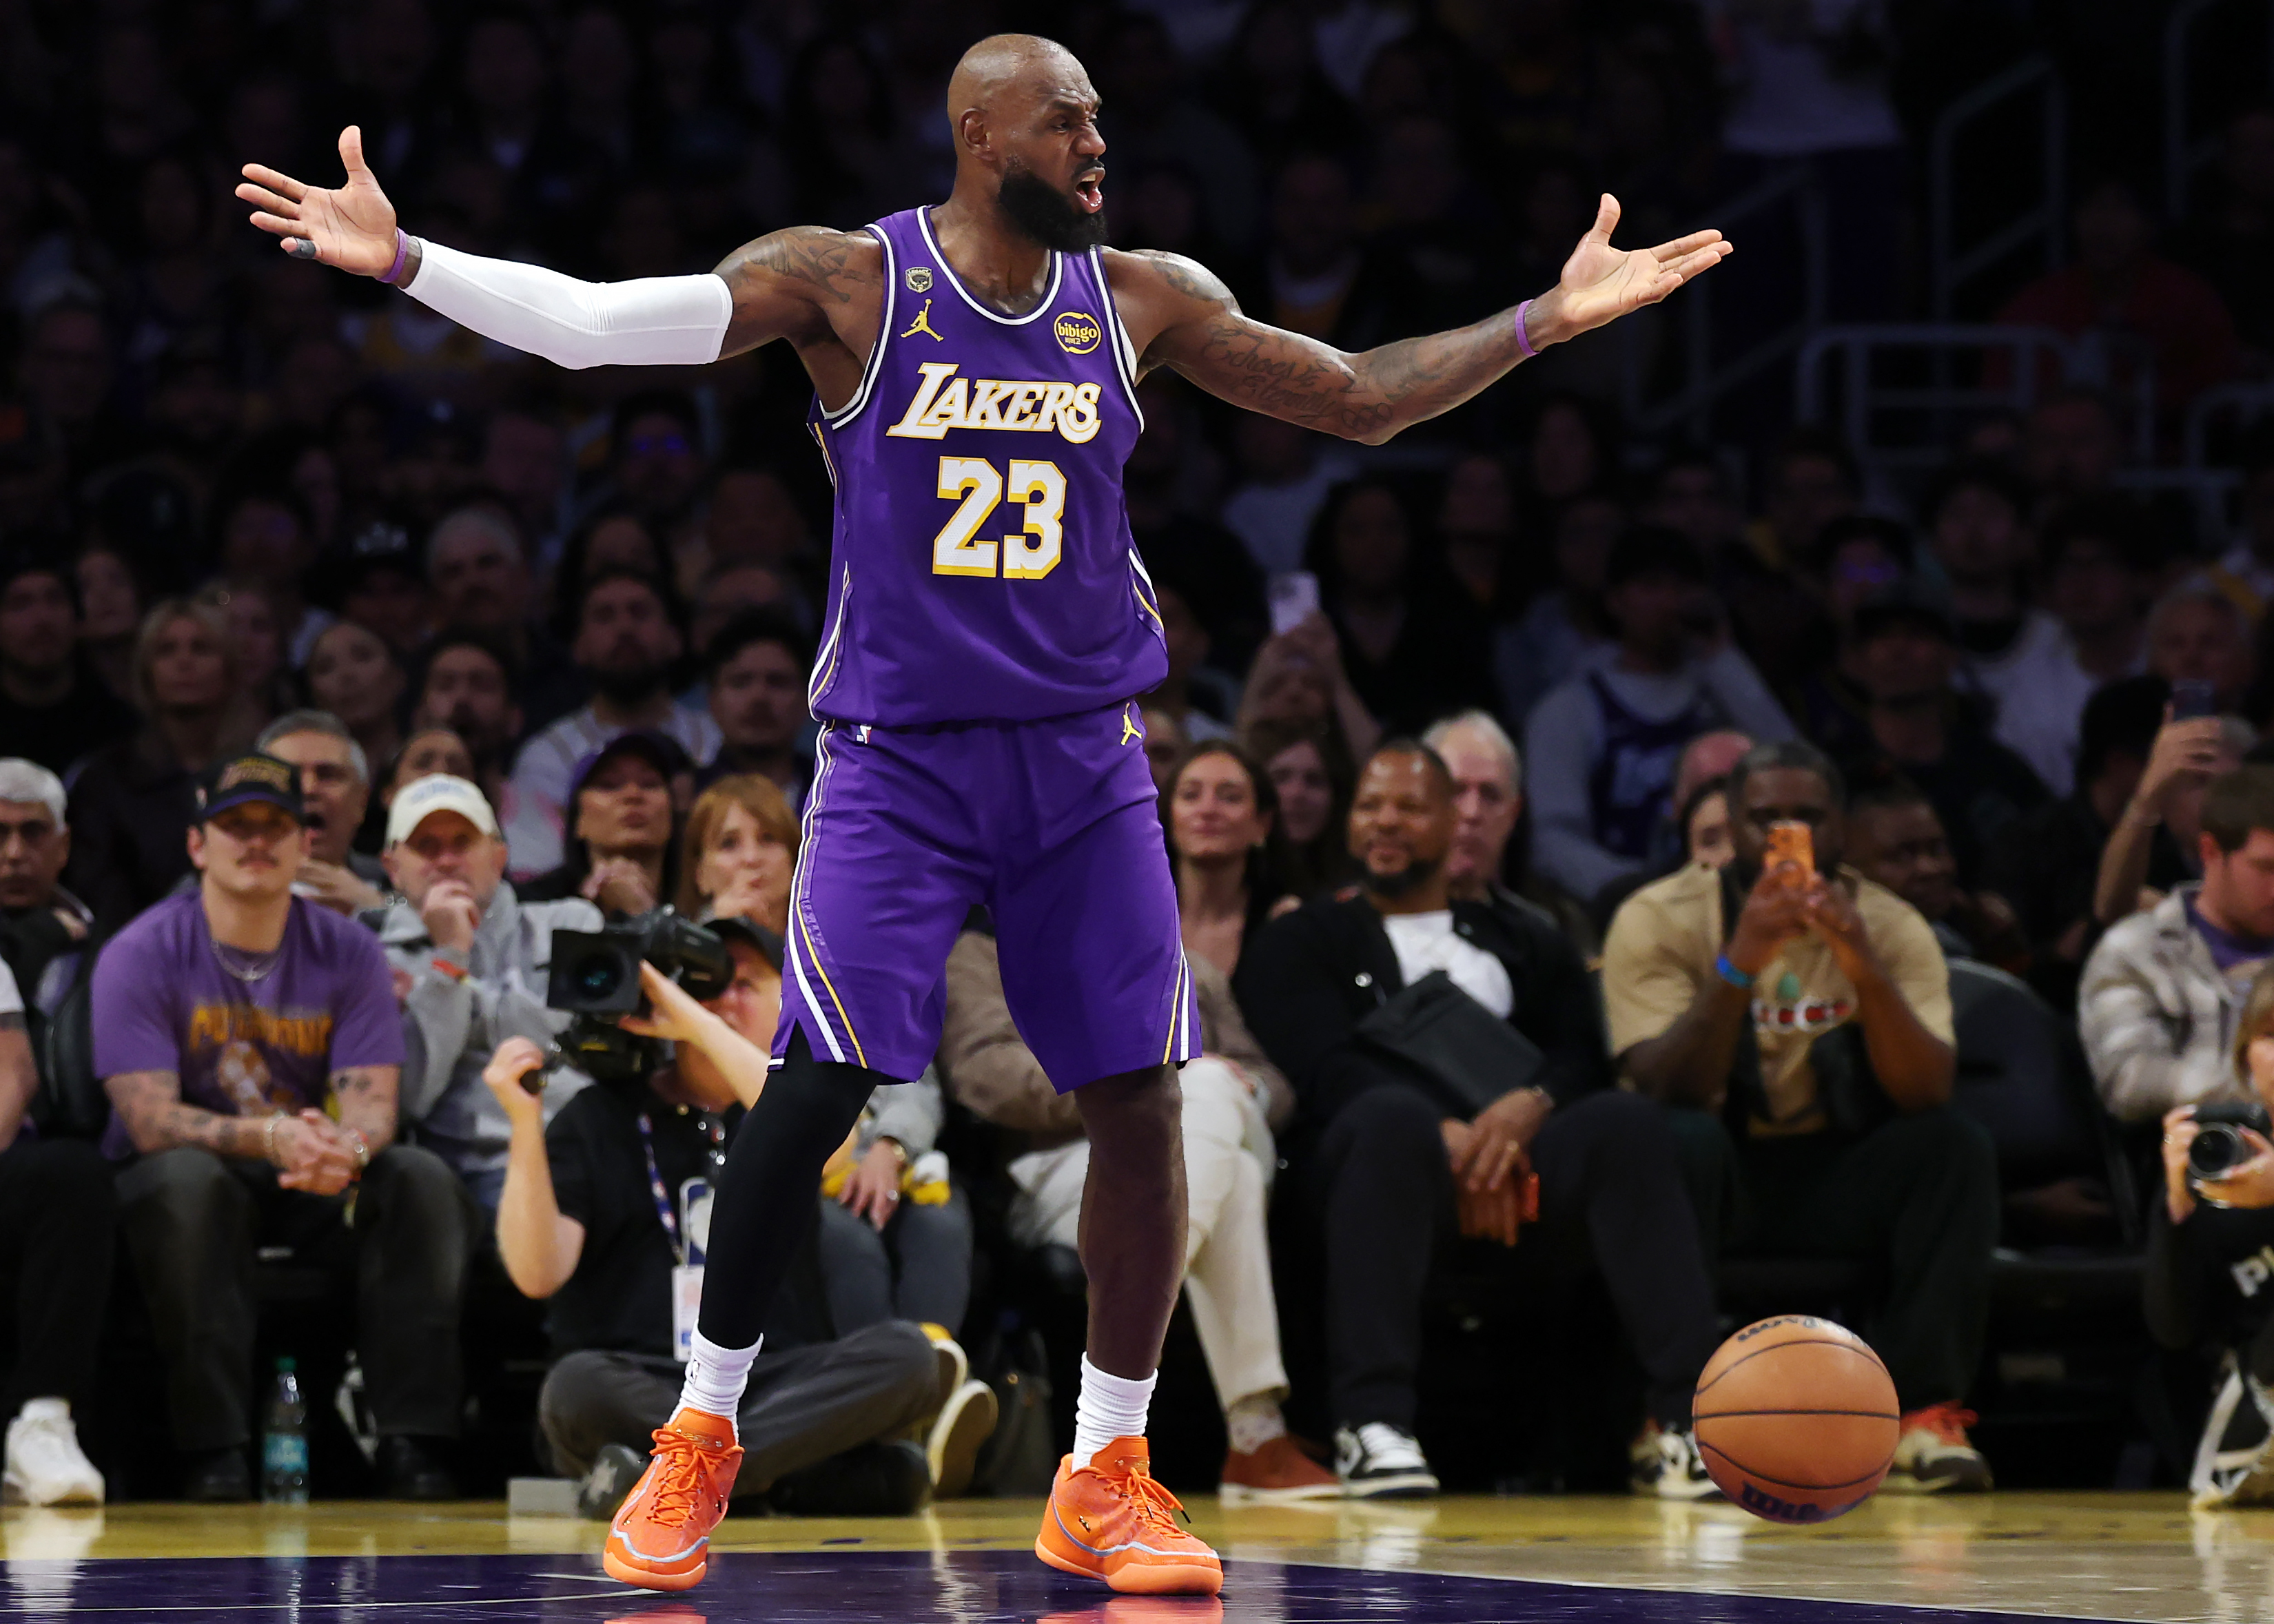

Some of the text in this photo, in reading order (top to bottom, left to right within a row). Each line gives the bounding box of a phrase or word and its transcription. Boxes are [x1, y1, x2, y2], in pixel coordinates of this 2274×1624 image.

[1058, 322, 1098, 343] bibigo
[886, 362, 1102, 444] LAKERS
[932, 455, 1067, 579] 23
